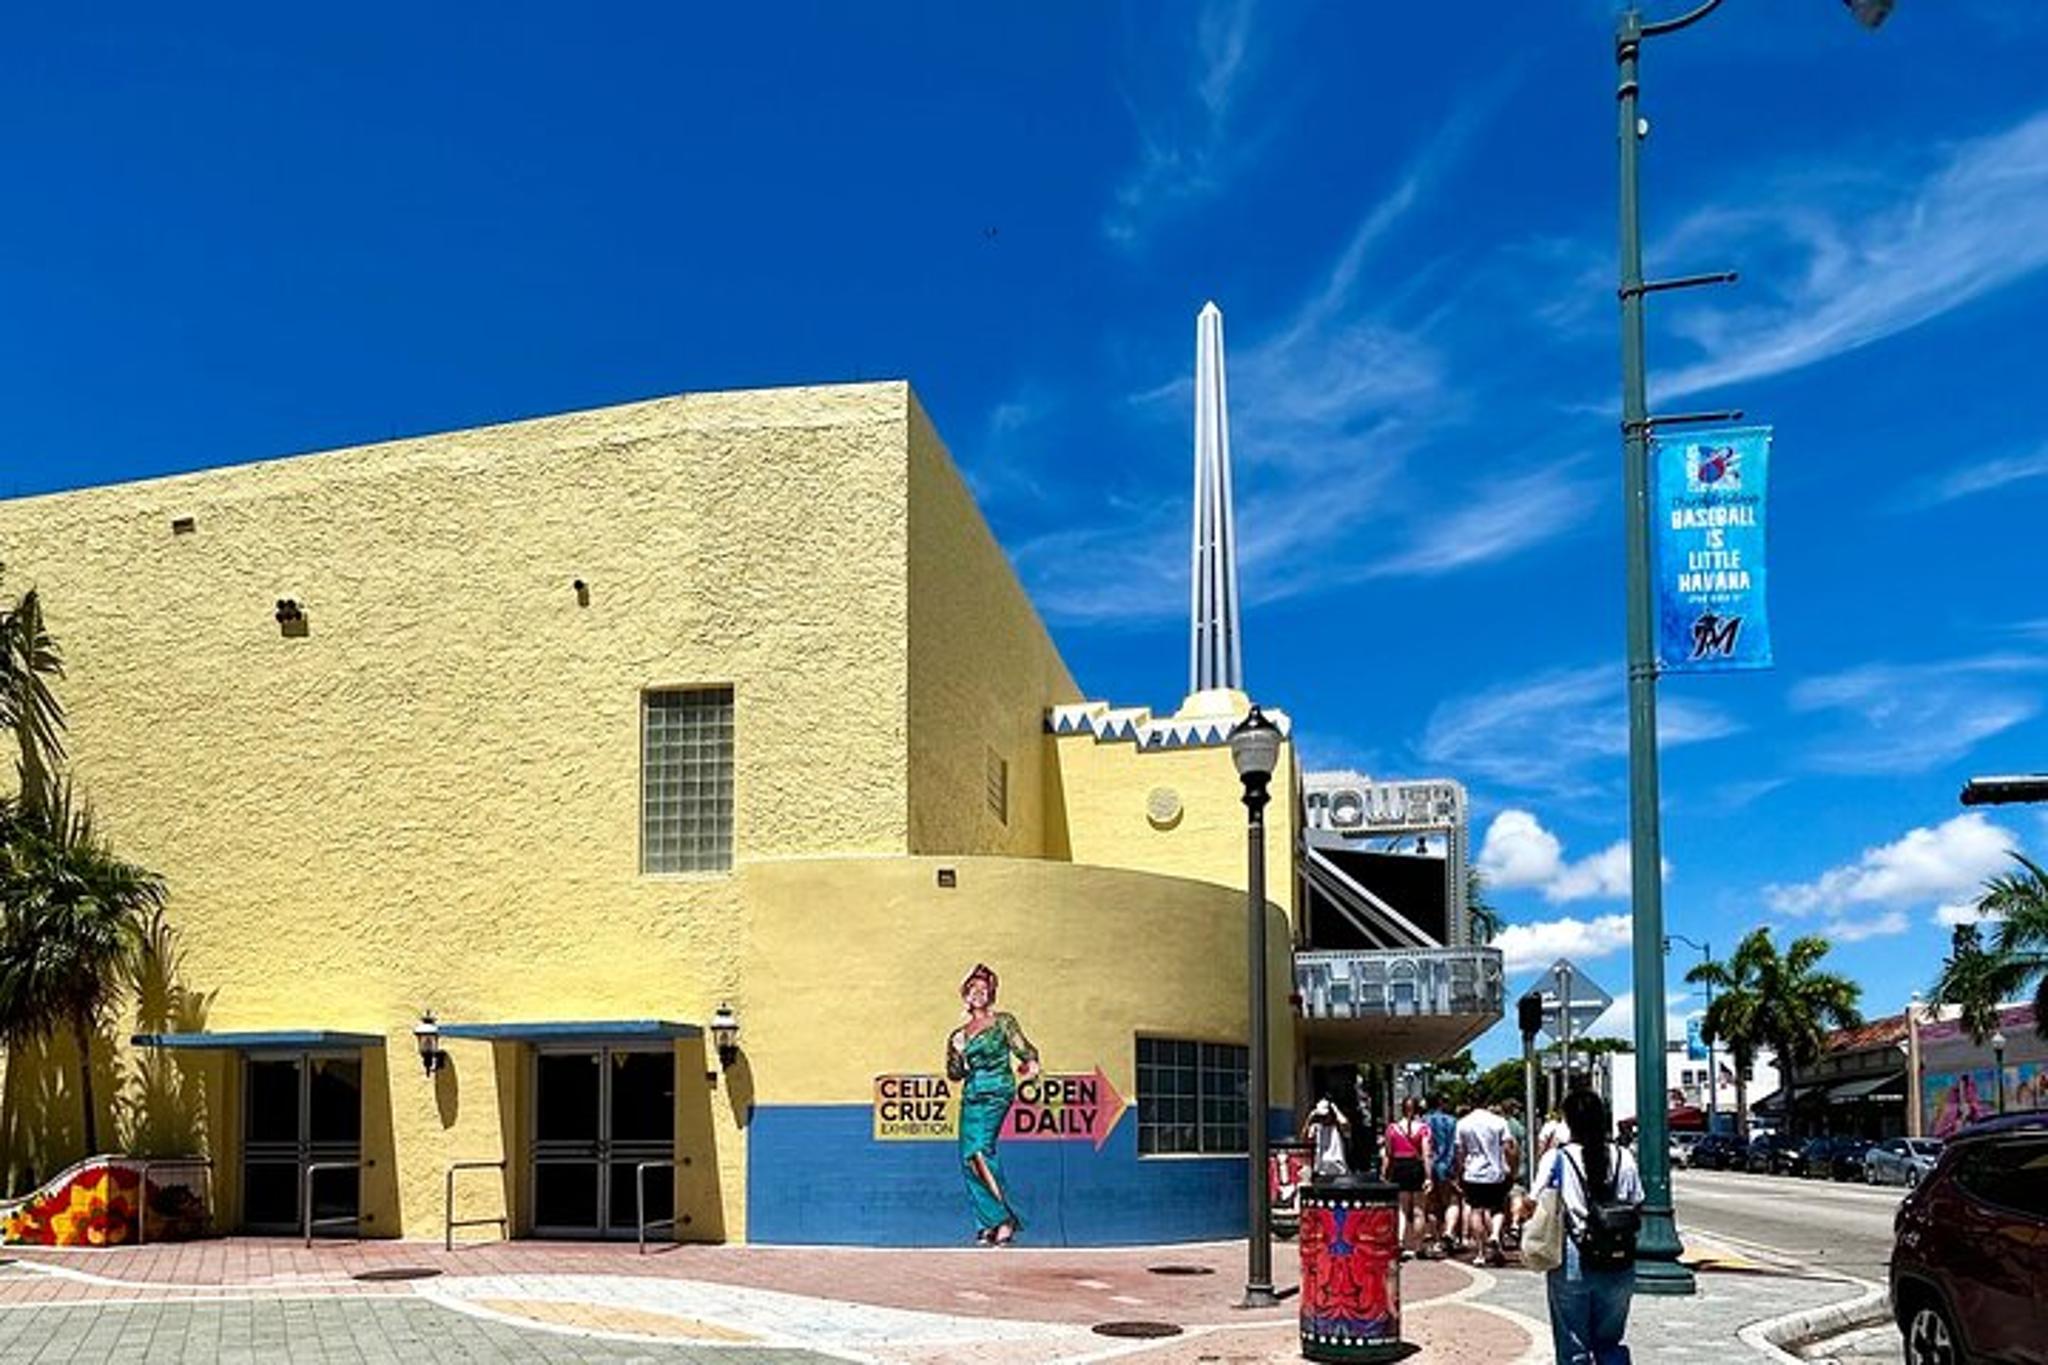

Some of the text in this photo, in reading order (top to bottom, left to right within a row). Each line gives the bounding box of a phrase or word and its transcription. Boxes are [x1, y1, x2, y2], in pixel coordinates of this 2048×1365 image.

[1672, 505, 1756, 529] BASEBALL
[1706, 529, 1724, 548] IS
[1689, 550, 1741, 570] LITTLE
[1678, 570, 1750, 592] HAVANA
[1306, 785, 1456, 828] TOWER
[881, 1079, 950, 1098] CELIA
[1017, 1080, 1098, 1105] OPEN
[881, 1101, 946, 1122] CRUZ
[1014, 1109, 1098, 1134] DAILY
[881, 1123, 953, 1135] EXHIBITION
